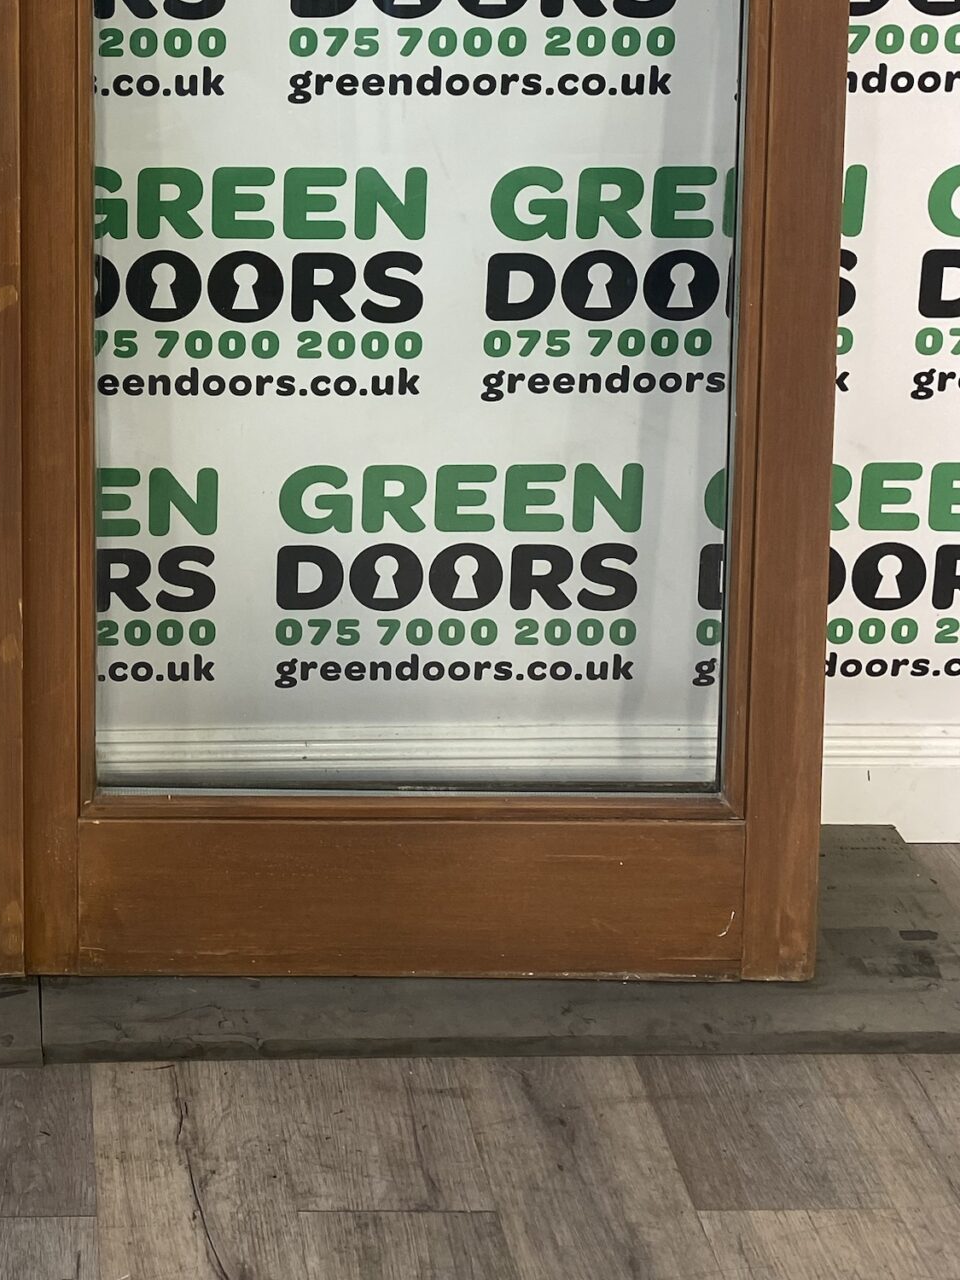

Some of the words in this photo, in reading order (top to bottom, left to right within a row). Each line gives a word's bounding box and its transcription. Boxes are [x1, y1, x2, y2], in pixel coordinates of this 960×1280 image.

[99, 27, 227, 59] 2000
[289, 27, 379, 57] 075
[399, 27, 527, 57] 7000
[544, 25, 676, 58] 2000
[288, 66, 672, 105] greendoors.co.uk
[155, 330, 280, 359] 7000
[297, 330, 423, 360] 2000
[483, 329, 568, 358] 075
[587, 327, 713, 358] 7000
[279, 463, 646, 535] GREEN
[276, 543, 638, 612] DOORS
[100, 619, 215, 645] 2000
[276, 617, 359, 646] 075
[378, 618, 498, 646] 7000
[516, 618, 637, 646] 2000
[275, 654, 633, 688] greendoors.co.uk
